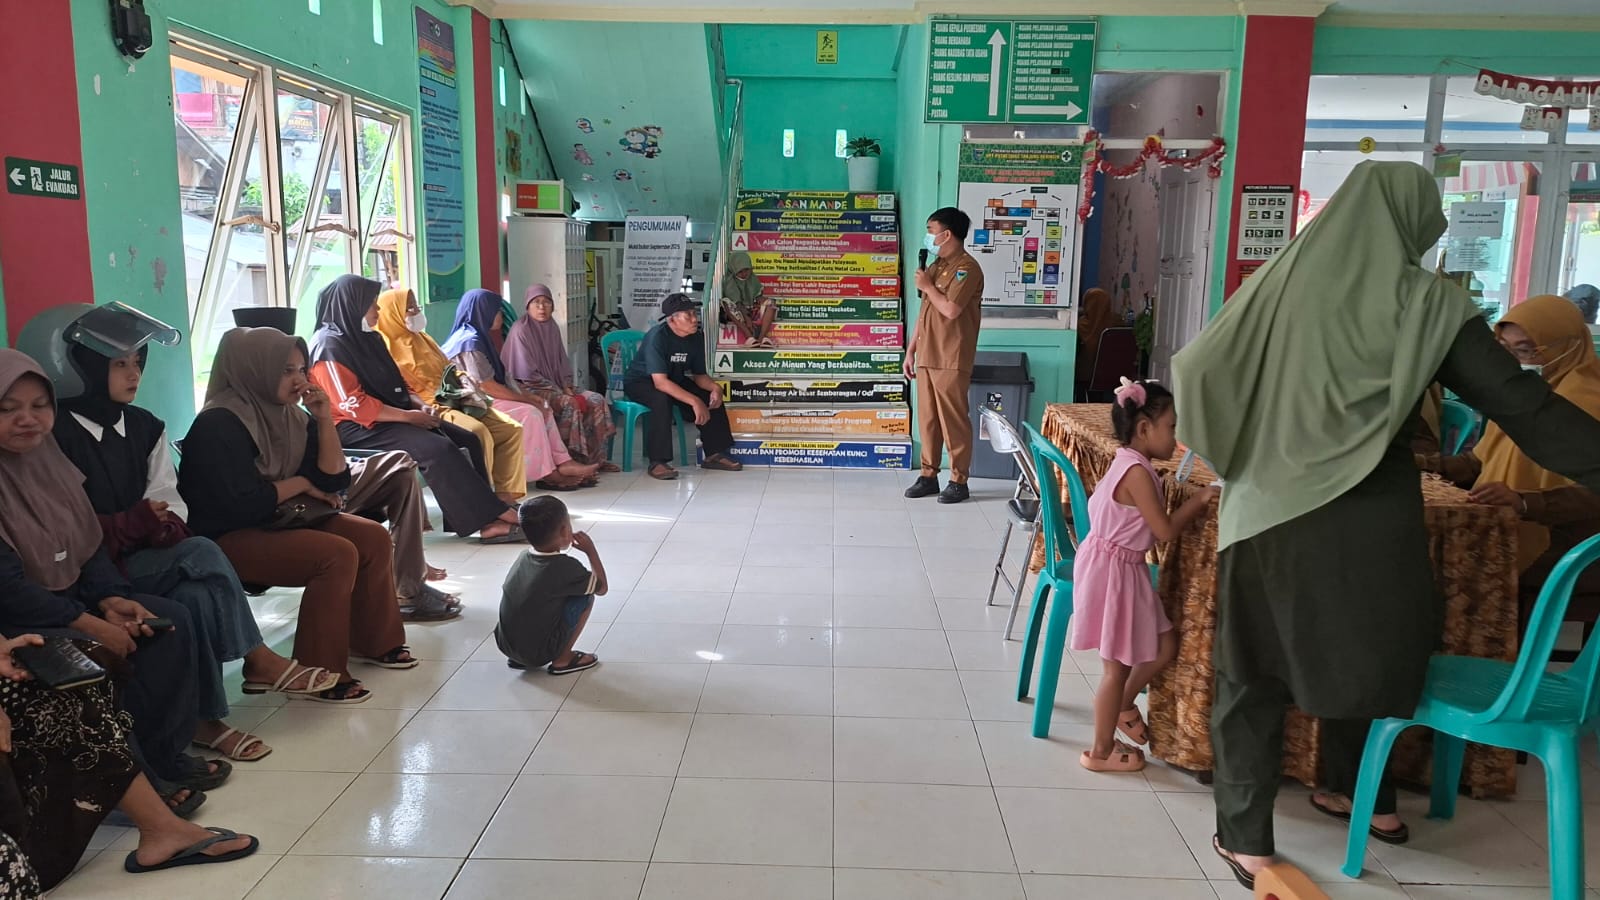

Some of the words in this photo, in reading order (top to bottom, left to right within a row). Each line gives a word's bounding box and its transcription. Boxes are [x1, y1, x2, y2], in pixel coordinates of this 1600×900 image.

[1362, 138, 1371, 151] 3
[50, 168, 72, 182] JALUR
[45, 181, 78, 195] EVAKUASI
[809, 200, 848, 210] MANDE
[628, 221, 681, 232] PENGUMUMAN
[740, 214, 746, 227] P
[734, 235, 746, 247] A
[722, 327, 736, 340] M
[718, 354, 731, 368] A
[743, 360, 767, 368] Akses
[768, 360, 780, 368] Air
[803, 361, 825, 370] Yang
[752, 389, 767, 397] Stop
[788, 389, 798, 397] Air
[774, 456, 824, 464] KEBERHASILAN
